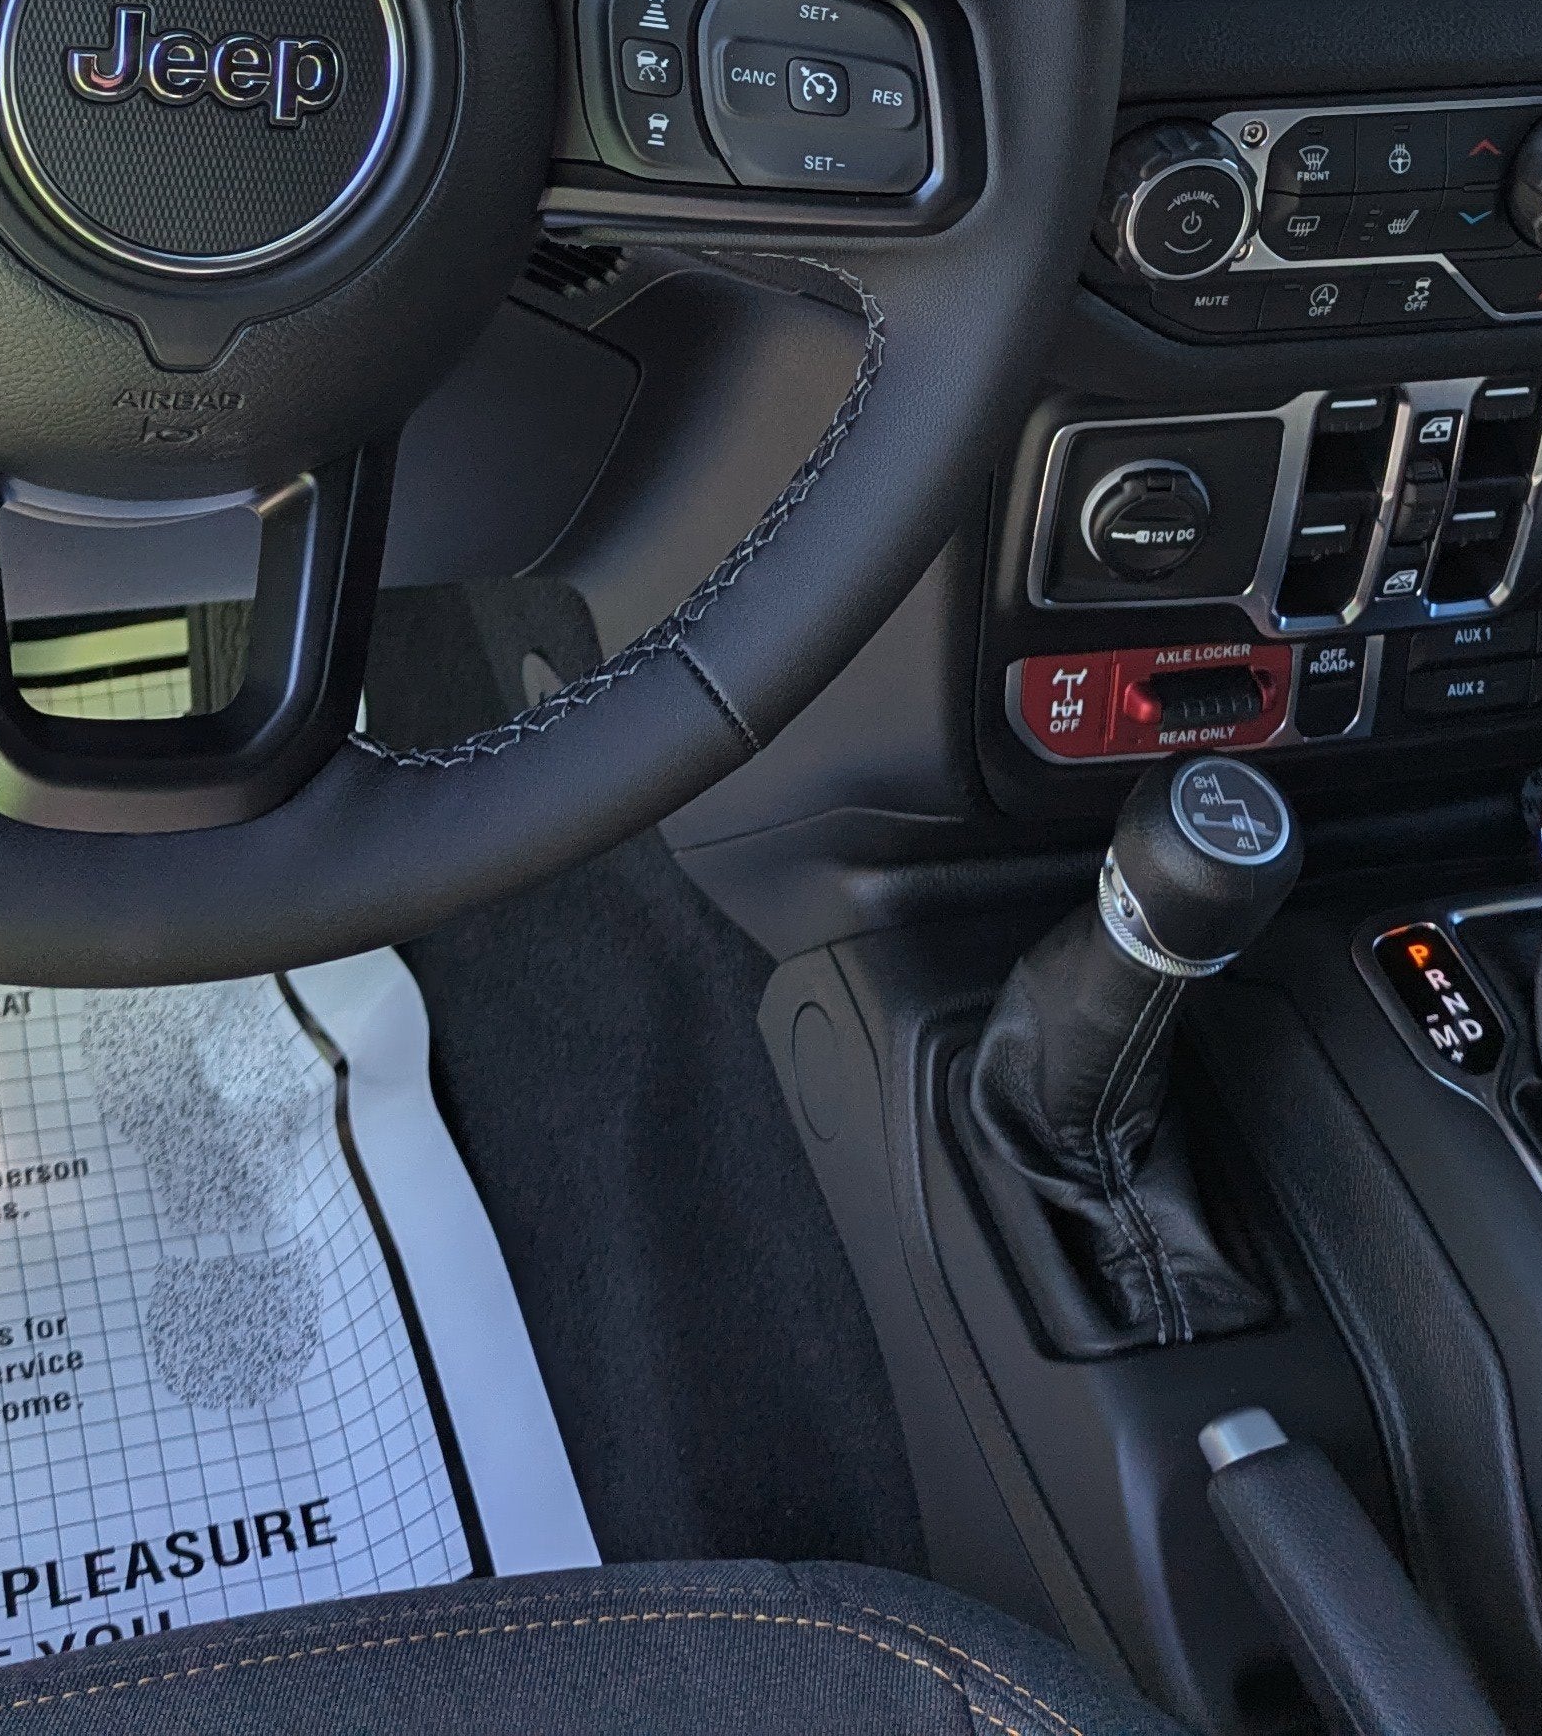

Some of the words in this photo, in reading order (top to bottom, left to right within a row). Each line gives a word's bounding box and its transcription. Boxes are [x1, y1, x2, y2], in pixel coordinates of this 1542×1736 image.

[68, 5, 345, 126] Jeep
[731, 67, 776, 87] CANC
[872, 89, 902, 107] RES
[1297, 171, 1330, 181] FRONT
[1172, 192, 1213, 206] VOLUME
[1195, 296, 1228, 307] MUTE
[1405, 299, 1428, 311] OFF
[1309, 305, 1331, 316] OFF
[1152, 531, 1174, 543] 12V
[1177, 529, 1194, 541] DC
[1455, 629, 1483, 643] AUX
[1485, 628, 1491, 641] 1
[1156, 650, 1191, 665] AXLE
[1196, 644, 1251, 661] LOCKER
[1447, 682, 1475, 696] AUX
[1476, 680, 1484, 694] 2
[1050, 718, 1080, 732] OFF
[1159, 730, 1196, 744] REAR
[1200, 727, 1235, 740] ONLY
[25, 1316, 67, 1342] for
[2, 1498, 338, 1618] PLEASURE
